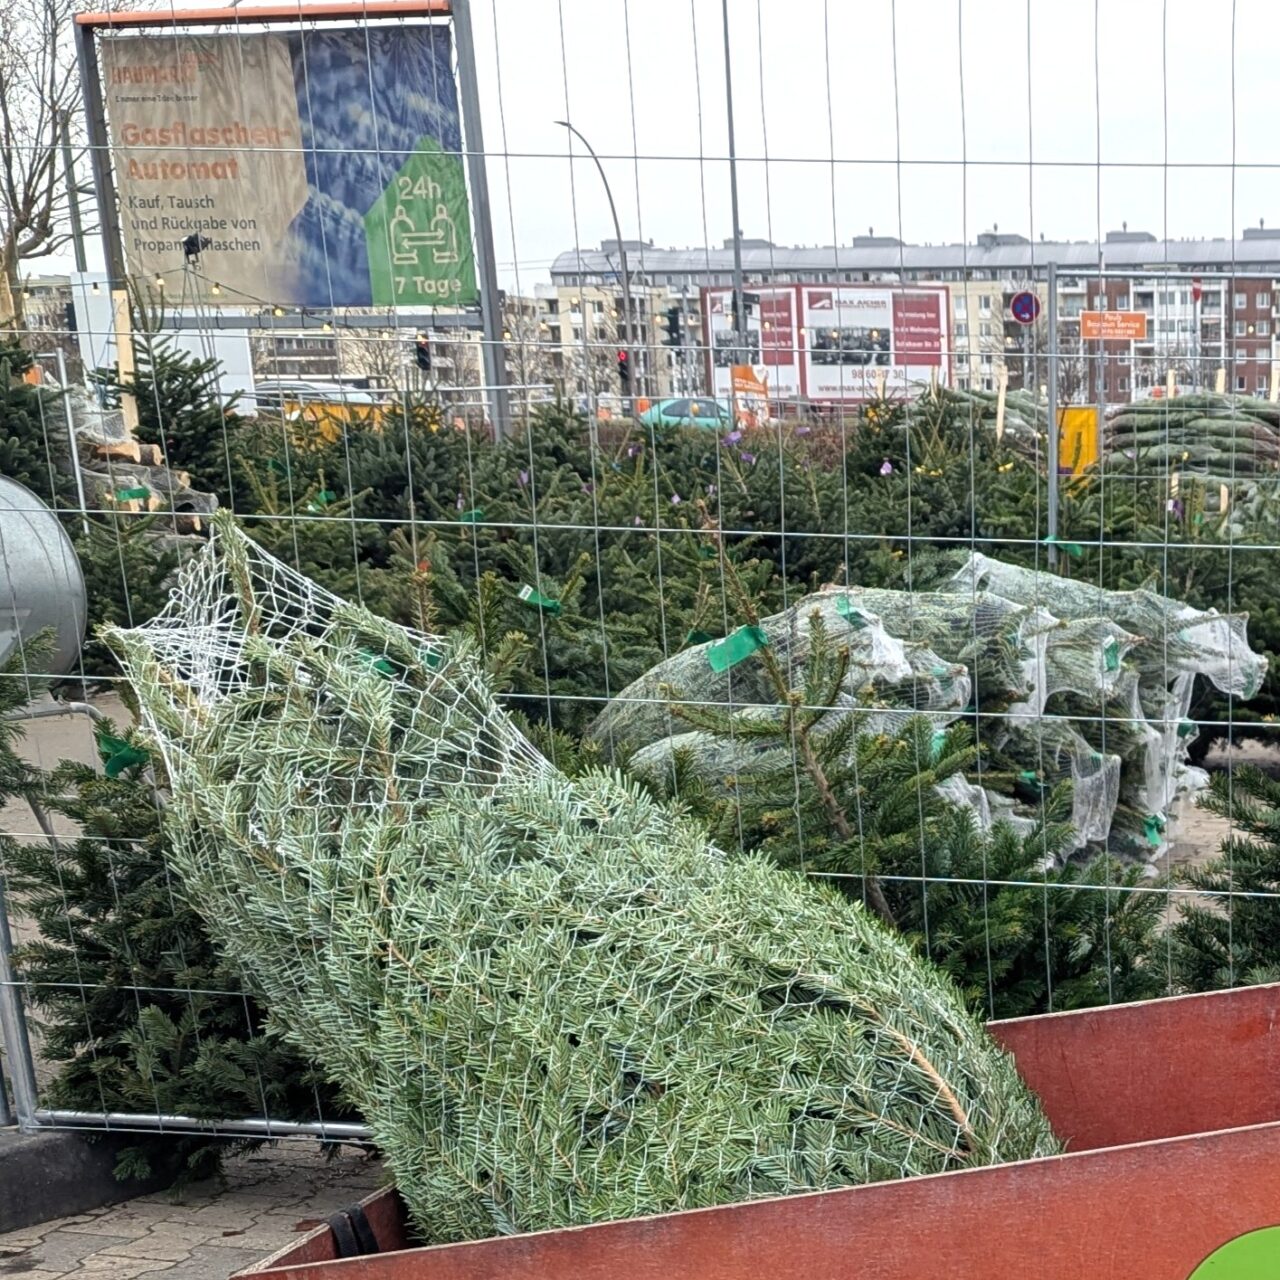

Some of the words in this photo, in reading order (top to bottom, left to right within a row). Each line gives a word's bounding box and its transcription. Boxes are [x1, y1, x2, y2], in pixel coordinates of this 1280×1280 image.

[121, 121, 291, 146] Gasflaschen-
[126, 157, 239, 180] Automat
[398, 176, 442, 200] 24h
[128, 195, 164, 210] Kauf,
[167, 194, 215, 209] Tausch
[131, 217, 158, 230] und
[161, 216, 228, 232] Rückgabe
[231, 218, 257, 230] von
[394, 276, 406, 294] 7
[412, 276, 462, 298] Tage
